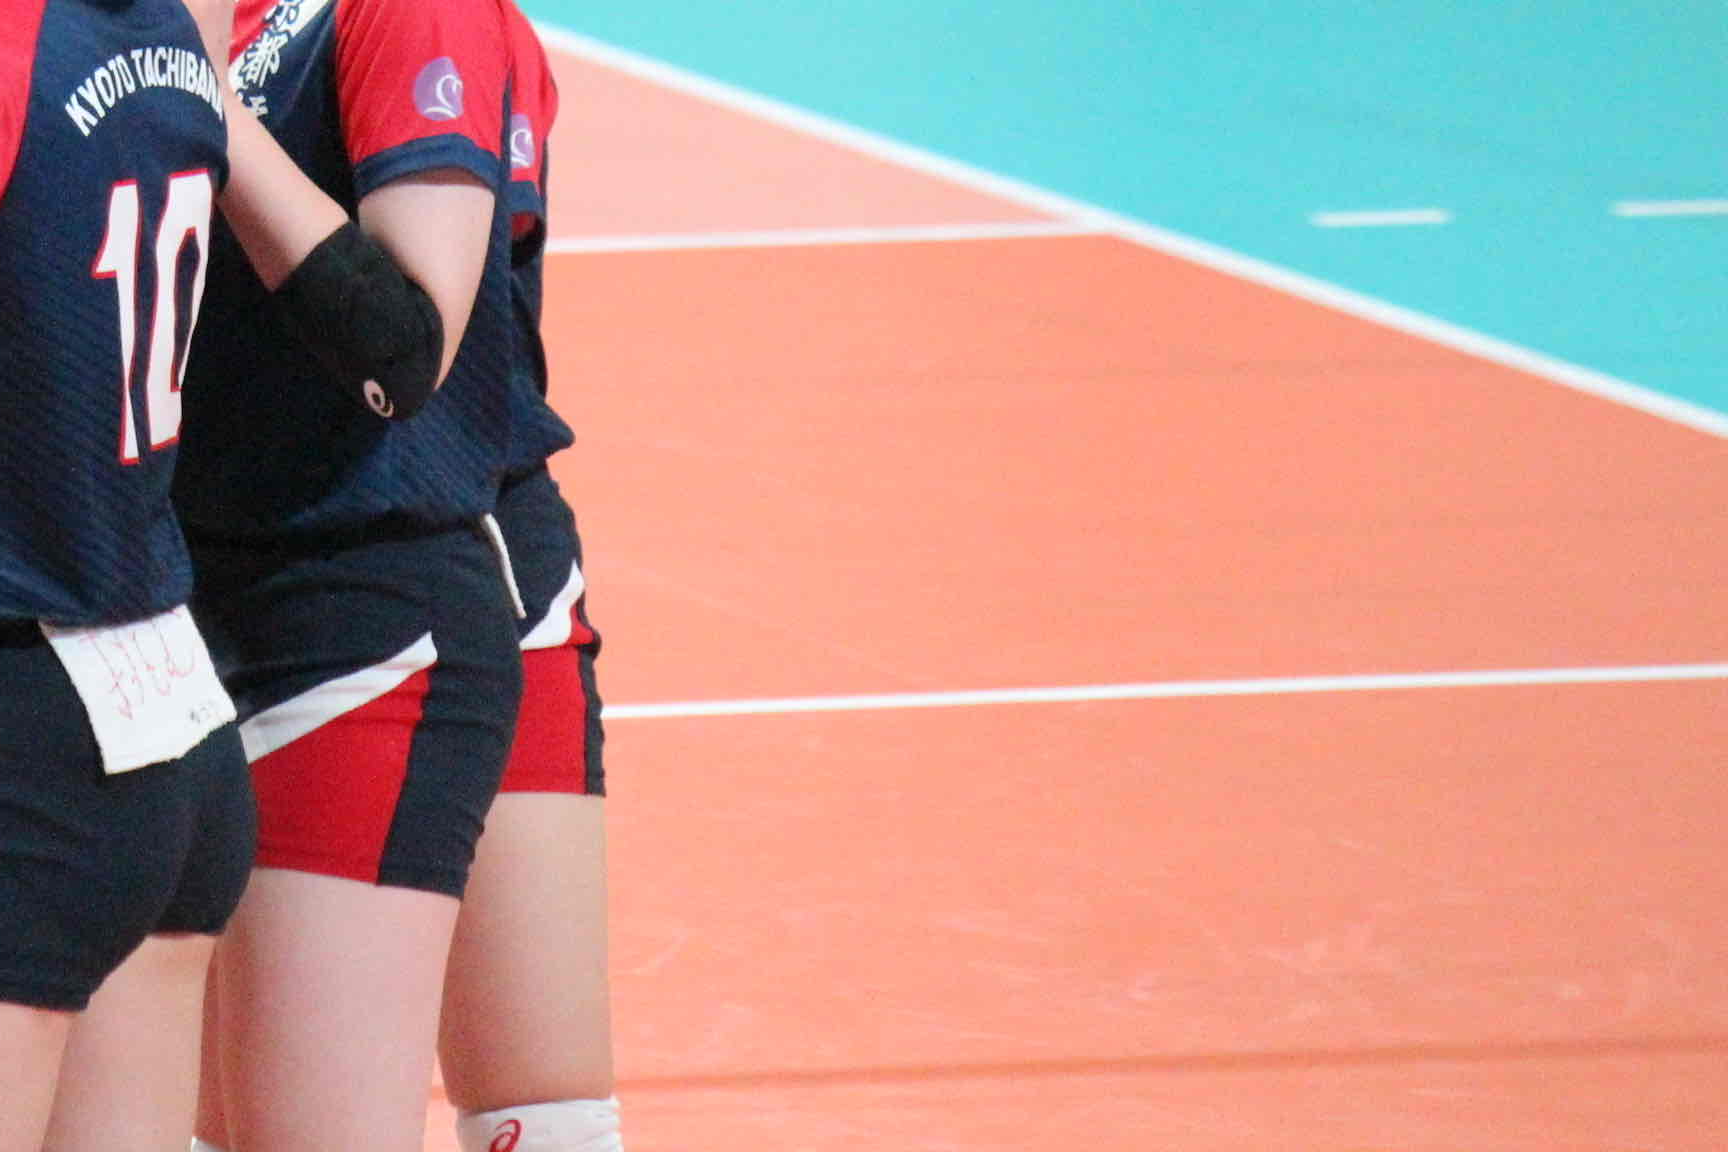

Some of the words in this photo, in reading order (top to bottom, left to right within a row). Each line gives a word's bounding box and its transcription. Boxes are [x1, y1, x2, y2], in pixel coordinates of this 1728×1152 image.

[64, 54, 136, 137] KYOTO
[130, 46, 224, 121] TACHIBAN
[91, 167, 213, 465] 10
